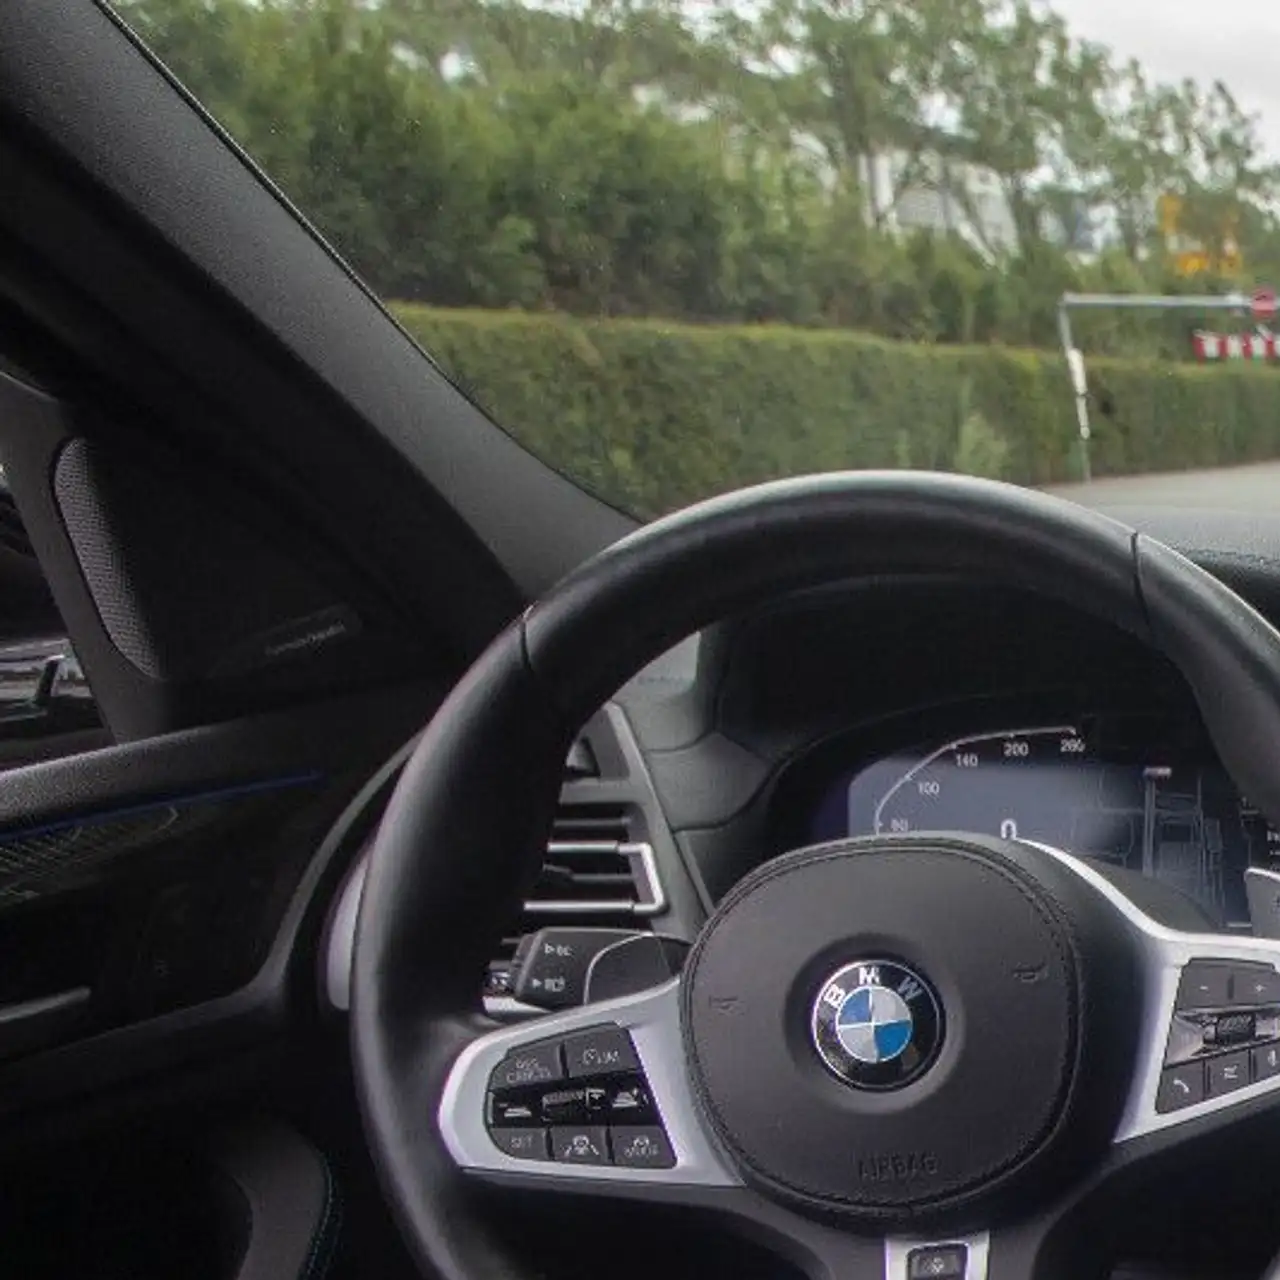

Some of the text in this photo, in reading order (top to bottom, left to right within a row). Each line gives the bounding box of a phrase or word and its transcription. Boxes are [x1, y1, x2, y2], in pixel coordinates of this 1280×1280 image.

[1003, 742, 1030, 757] 200
[955, 754, 979, 767] 140
[823, 966, 923, 1009] BMW
